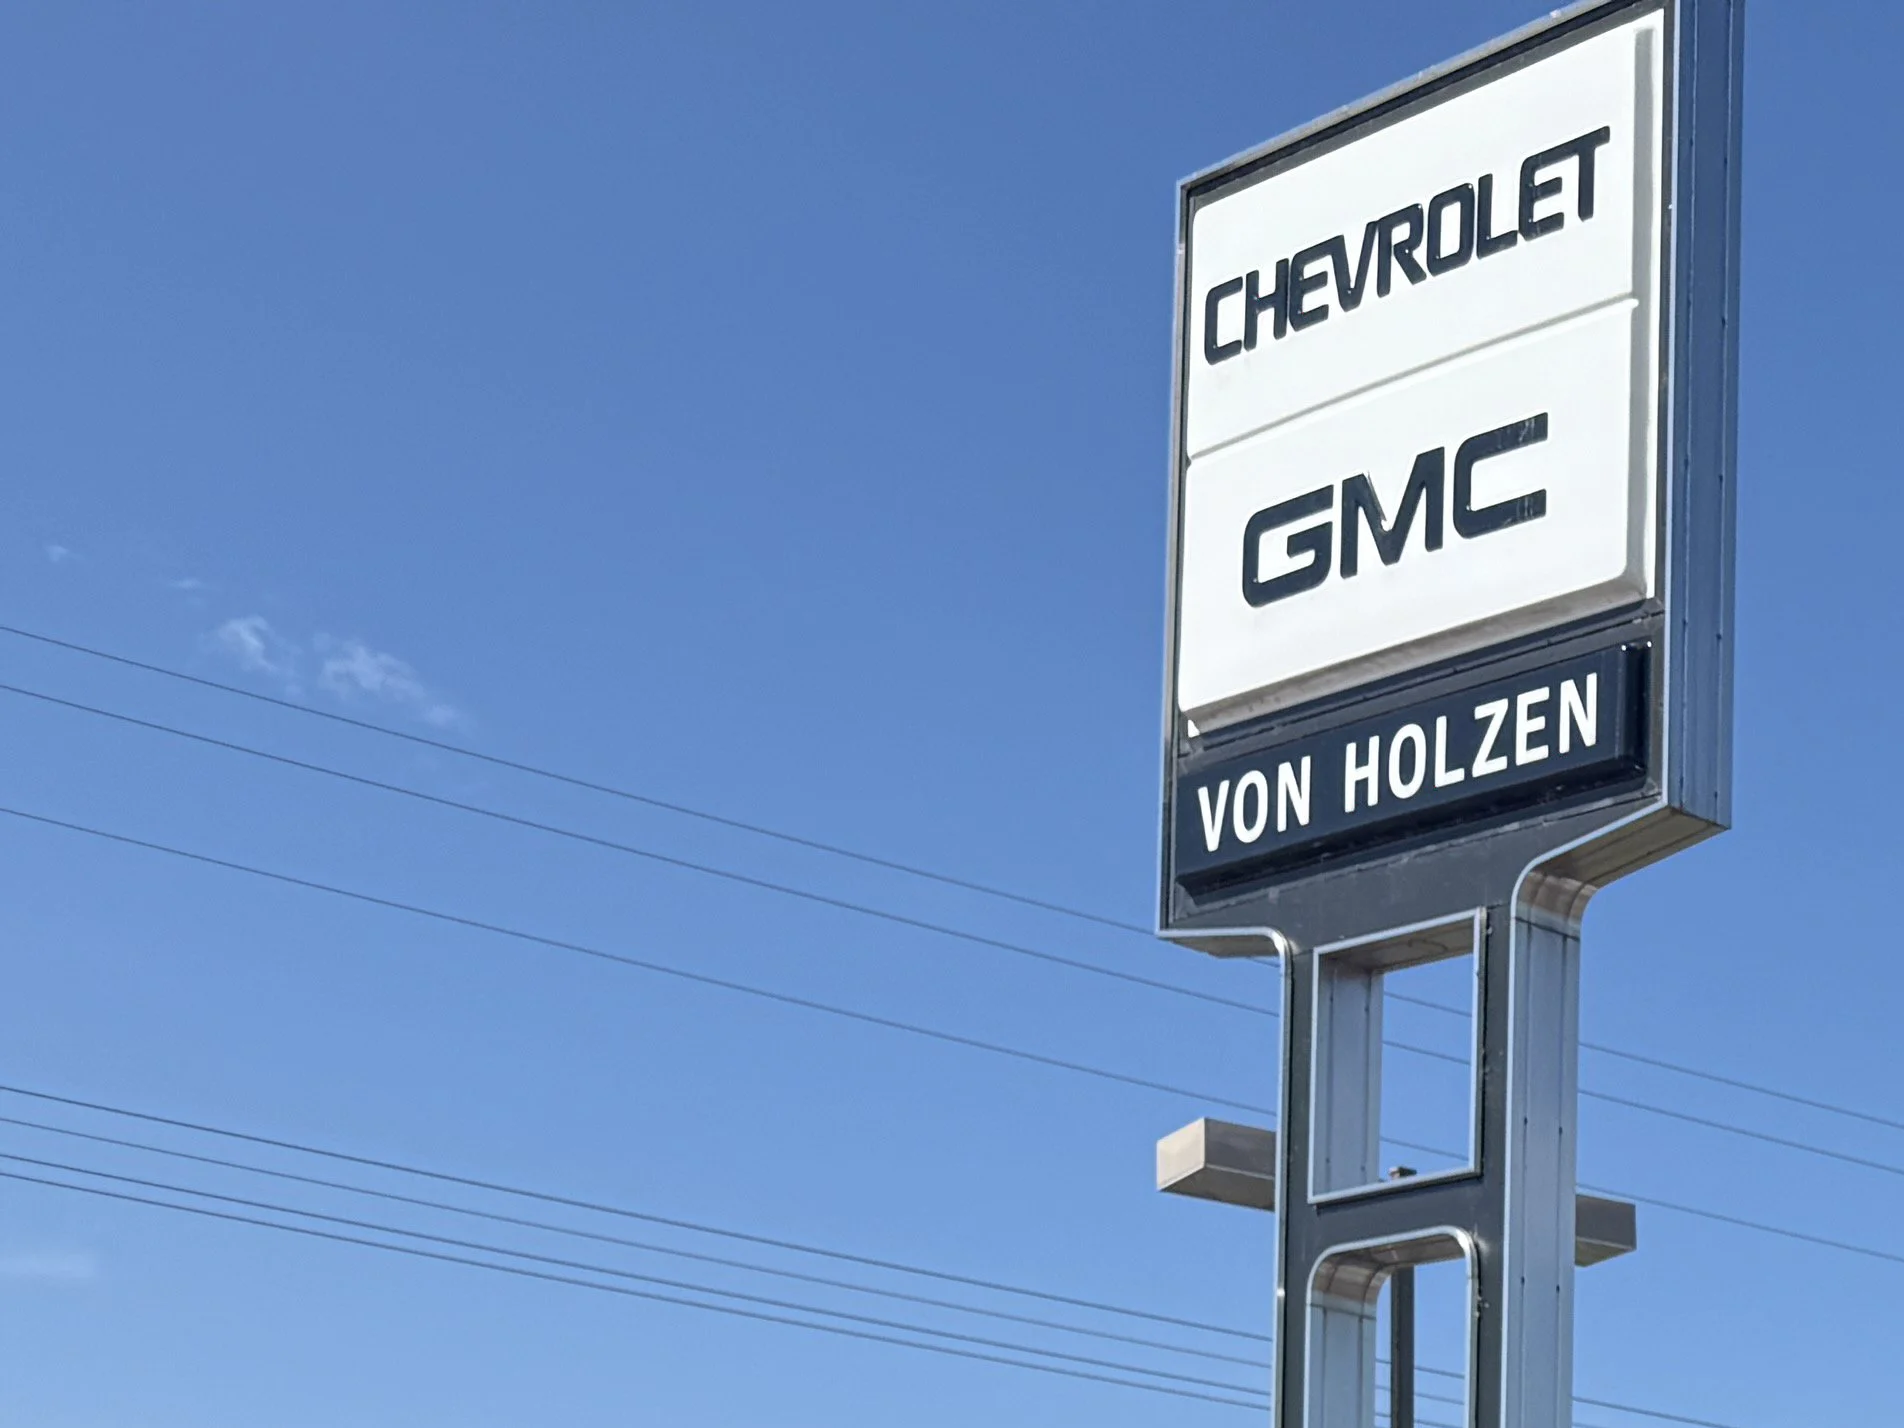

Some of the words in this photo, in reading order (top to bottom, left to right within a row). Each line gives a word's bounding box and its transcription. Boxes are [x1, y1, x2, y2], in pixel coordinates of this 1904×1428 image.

[1203, 126, 1610, 366] CHEVROLET
[1241, 412, 1549, 607] GMC
[1197, 754, 1313, 852] VON
[1344, 672, 1599, 813] HOLZEN
